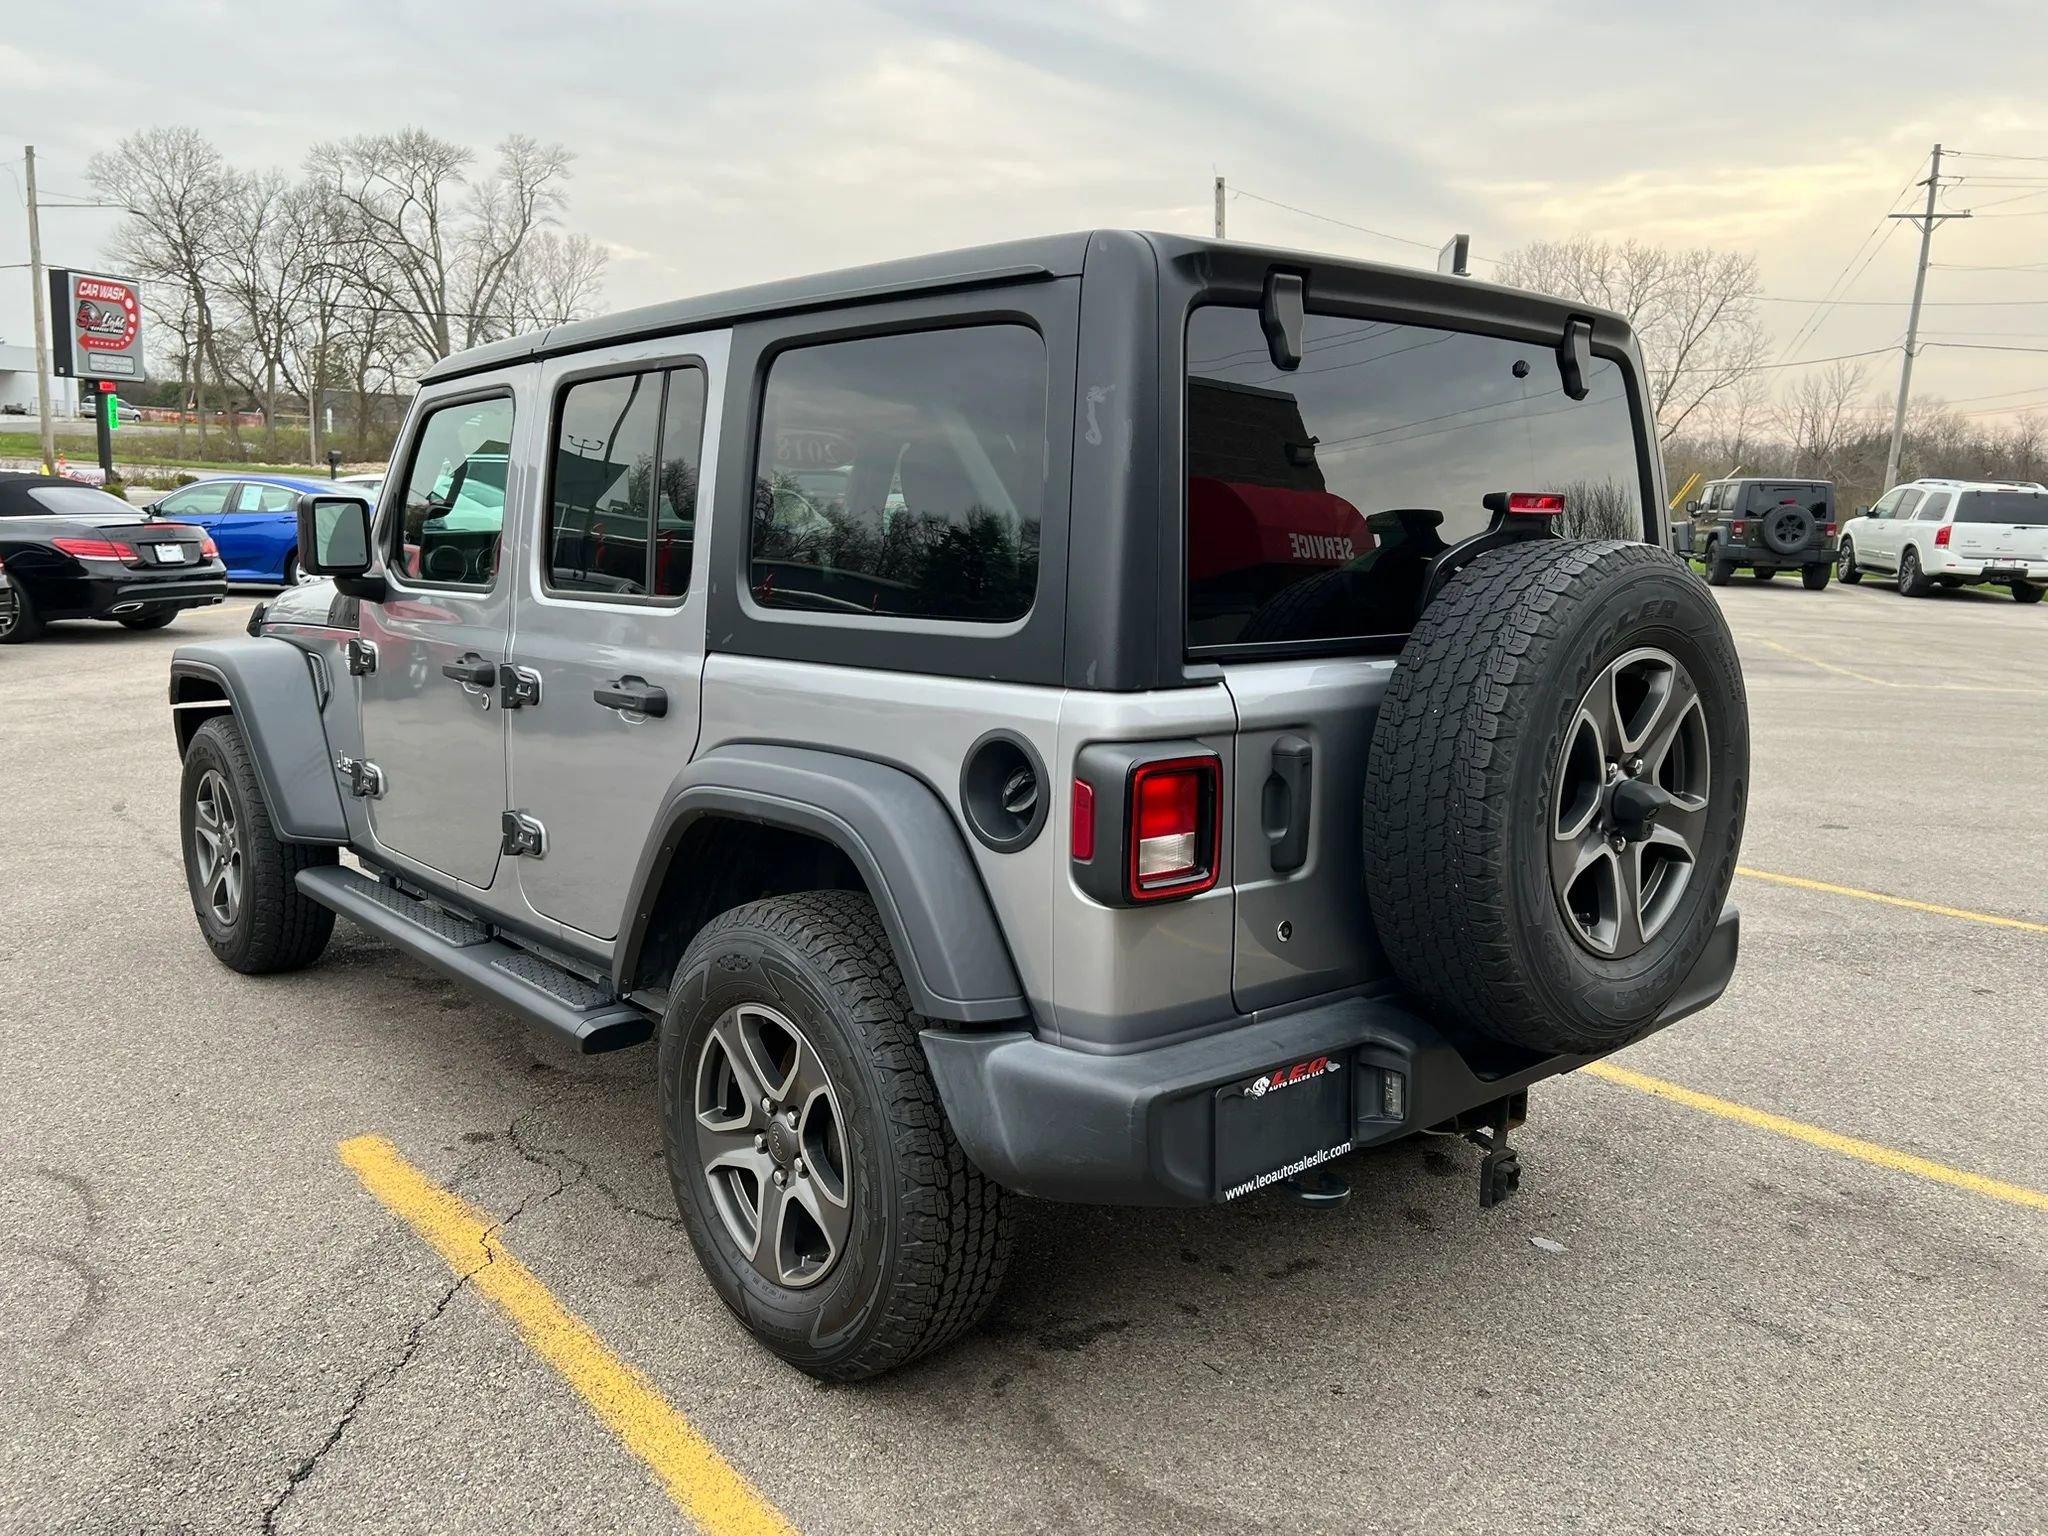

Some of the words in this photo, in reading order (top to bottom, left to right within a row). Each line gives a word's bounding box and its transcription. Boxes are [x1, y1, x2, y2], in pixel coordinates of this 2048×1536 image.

[79, 282, 98, 297] CAR
[99, 285, 126, 301] WASH
[1268, 1081, 1288, 1093] AUTO
[1288, 1073, 1311, 1085] SALES
[1311, 1068, 1325, 1078] LLC
[1271, 1056, 1328, 1086] LEO
[1225, 1142, 1351, 1201] www.leoautosalesllc.com
